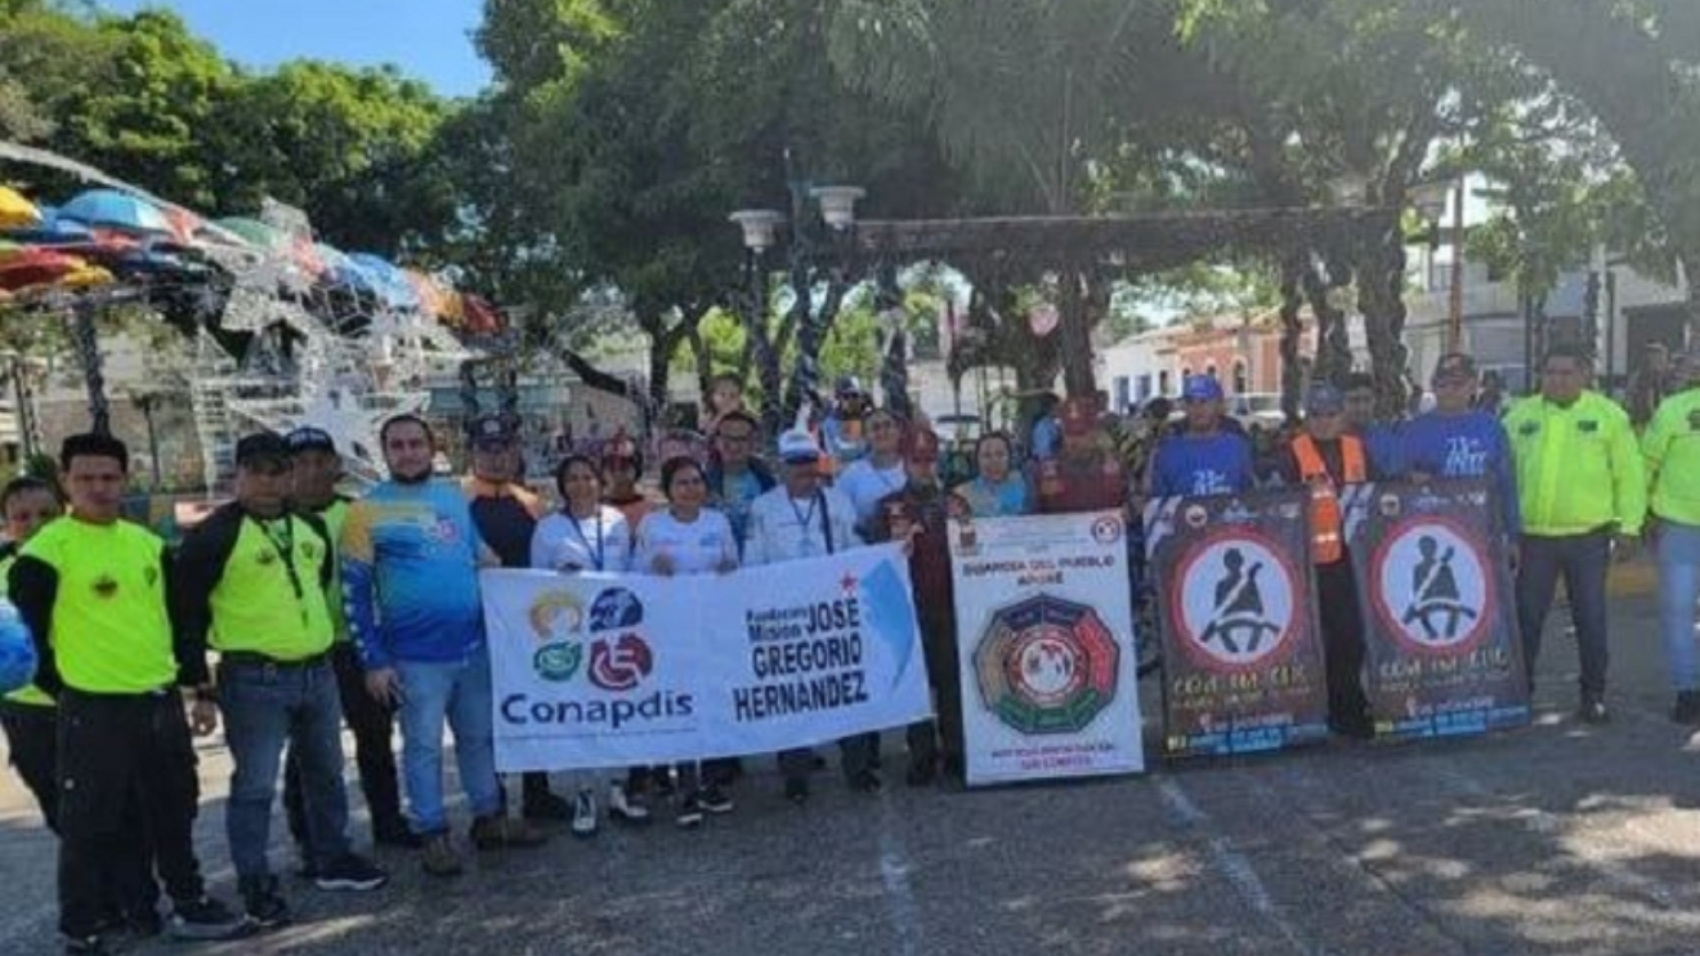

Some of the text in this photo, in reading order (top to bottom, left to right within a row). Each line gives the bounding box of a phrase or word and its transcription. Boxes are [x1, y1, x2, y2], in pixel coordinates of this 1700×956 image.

[753, 632, 862, 680] GREGORIO
[500, 690, 694, 729] Conapdis
[733, 669, 870, 723] HERNANDEZ
